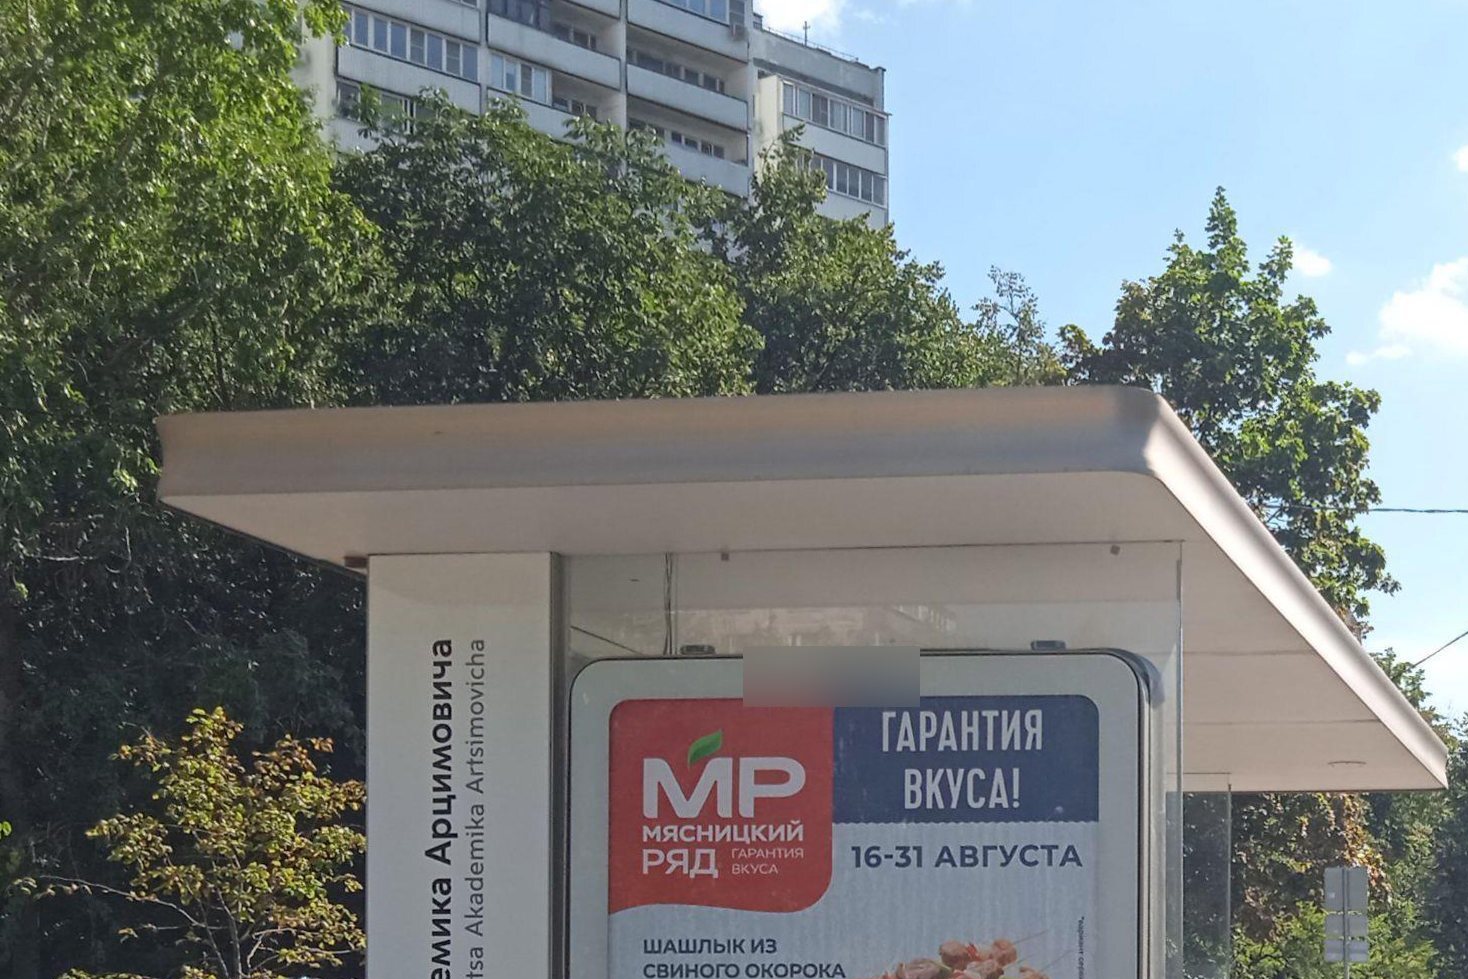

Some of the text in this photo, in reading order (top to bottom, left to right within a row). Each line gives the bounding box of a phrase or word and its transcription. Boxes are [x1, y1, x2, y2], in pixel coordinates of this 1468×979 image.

[465, 638, 486, 794] Artsimovicha
[882, 709, 1043, 752] ГАРАНТИЯ
[424, 638, 458, 866] Арцимовича
[643, 757, 806, 819] МР
[904, 767, 1020, 809] ВКУСА!
[642, 820, 804, 844] МЯСНИЦКИЙ
[643, 849, 719, 878] РЯД
[731, 848, 804, 859] ГАРАНТИЯ
[851, 845, 1083, 868] 16-31 АВГУСТА
[465, 803, 485, 937] Akademika
[731, 863, 779, 875] ВКУСА
[643, 938, 777, 954] ШАШЛЫК ИЗ
[643, 963, 846, 979] СВИНОГО ОКОРОКА
